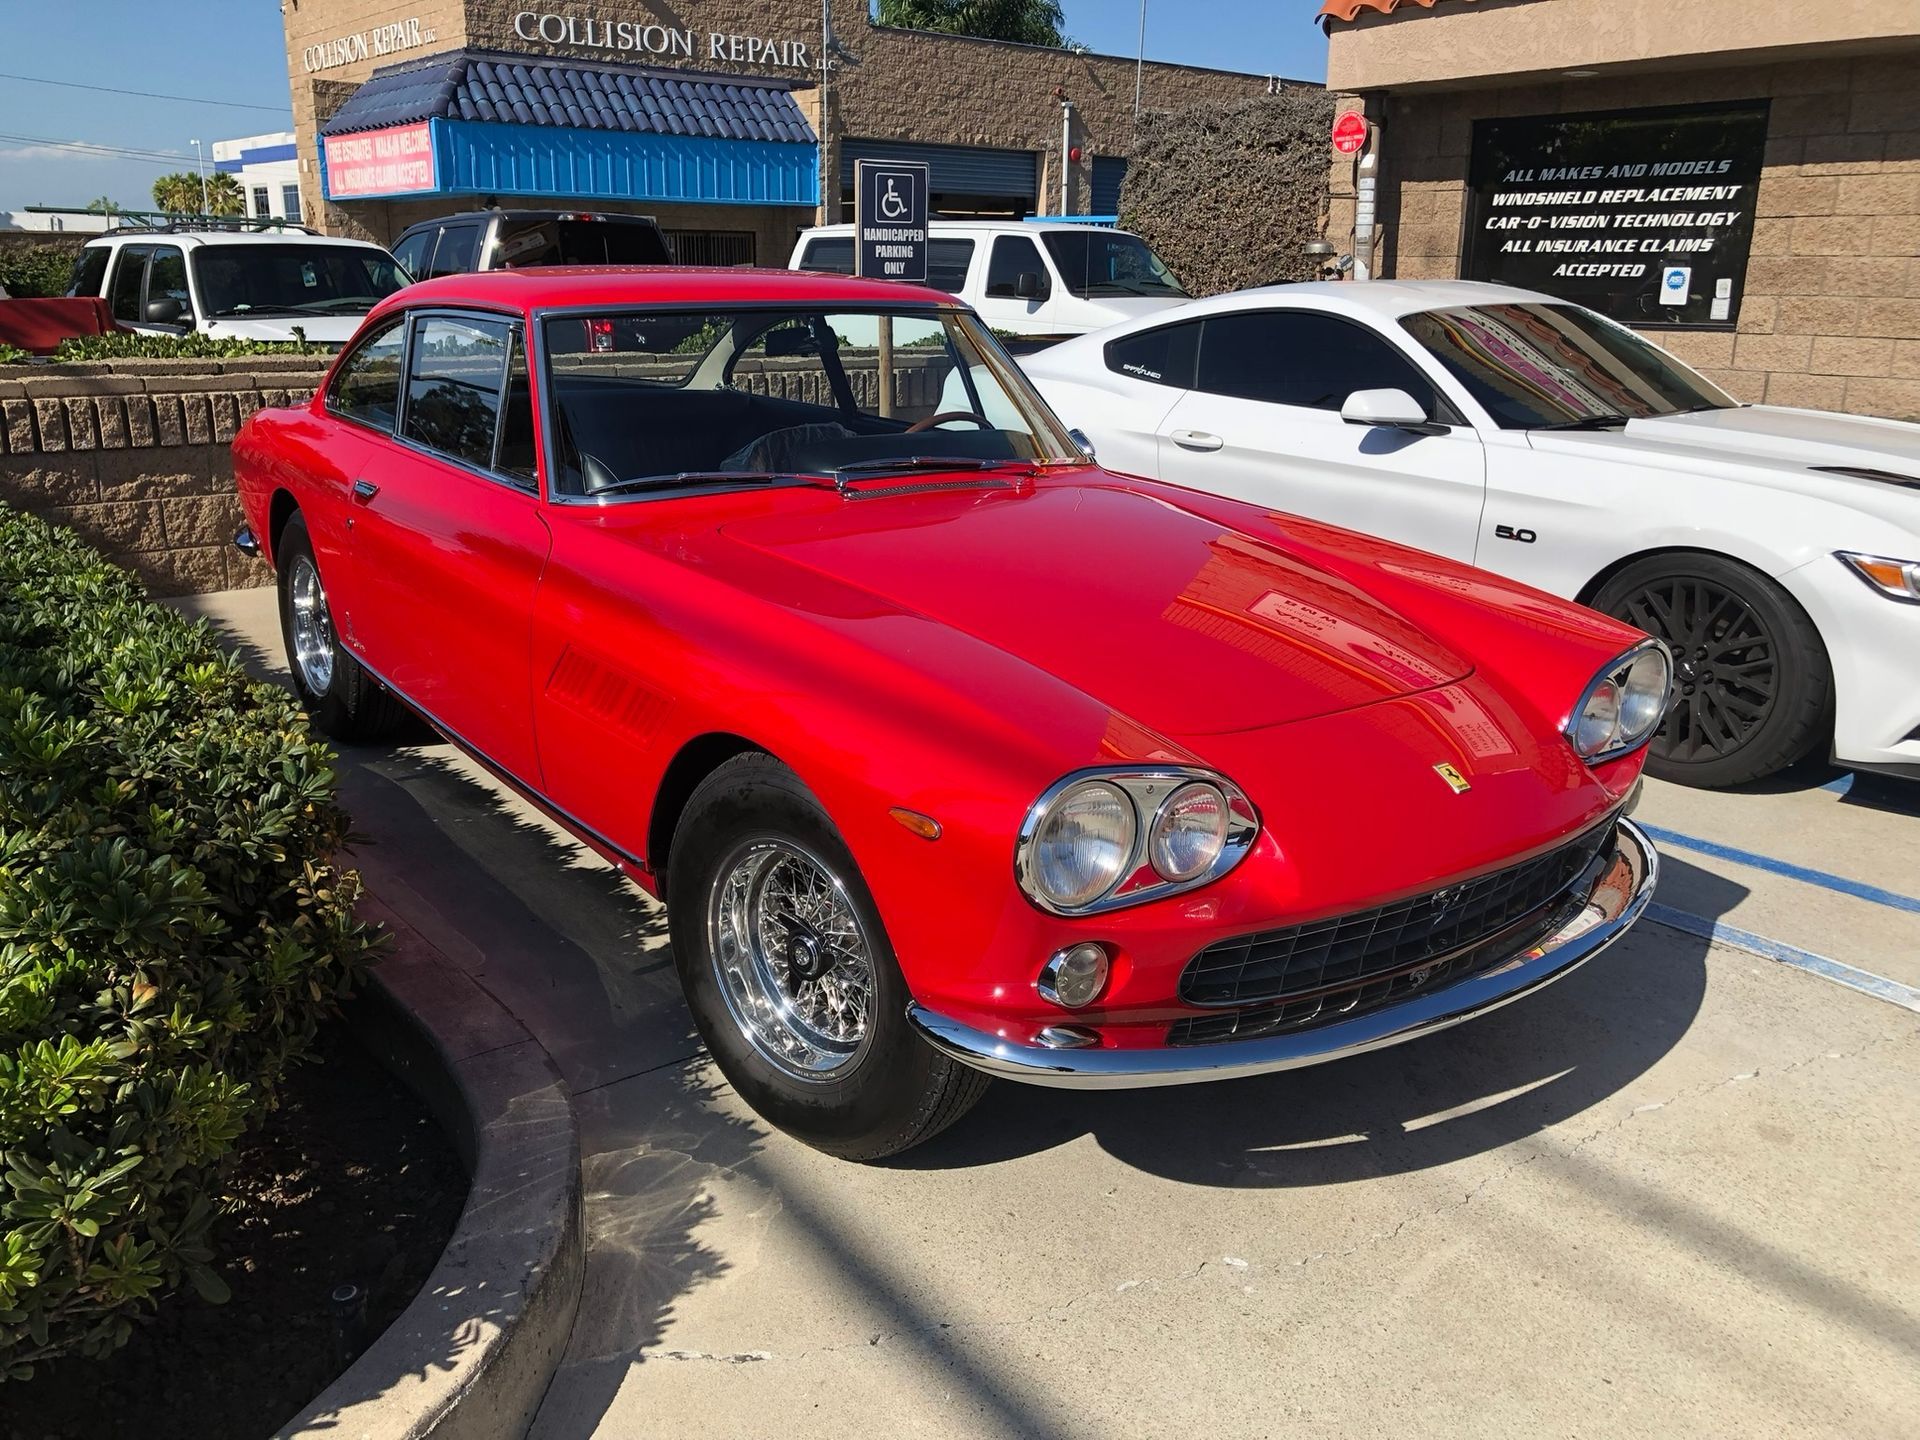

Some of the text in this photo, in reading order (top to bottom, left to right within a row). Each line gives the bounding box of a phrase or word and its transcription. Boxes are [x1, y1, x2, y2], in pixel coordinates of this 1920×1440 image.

[304, 32, 368, 73] COLLISION
[373, 18, 422, 55] REPAIR
[515, 12, 692, 56] COLLISION
[709, 32, 810, 68] REPAIR
[1502, 160, 1732, 182] ALL MAKES AND MODELS
[1492, 185, 1742, 206] WINDSHIELD REPLACEMENT
[1485, 212, 1742, 230] CAR-O-VISION TECHNOLOGY
[864, 228, 924, 241] HANDICAPPED
[875, 245, 914, 258] PARKING
[1500, 238, 1715, 253] ALL INSURANCE CLAIMS
[884, 262, 906, 274] ONLY
[1553, 263, 1646, 277] ACCEPTED
[1495, 524, 1537, 543] 5.0
